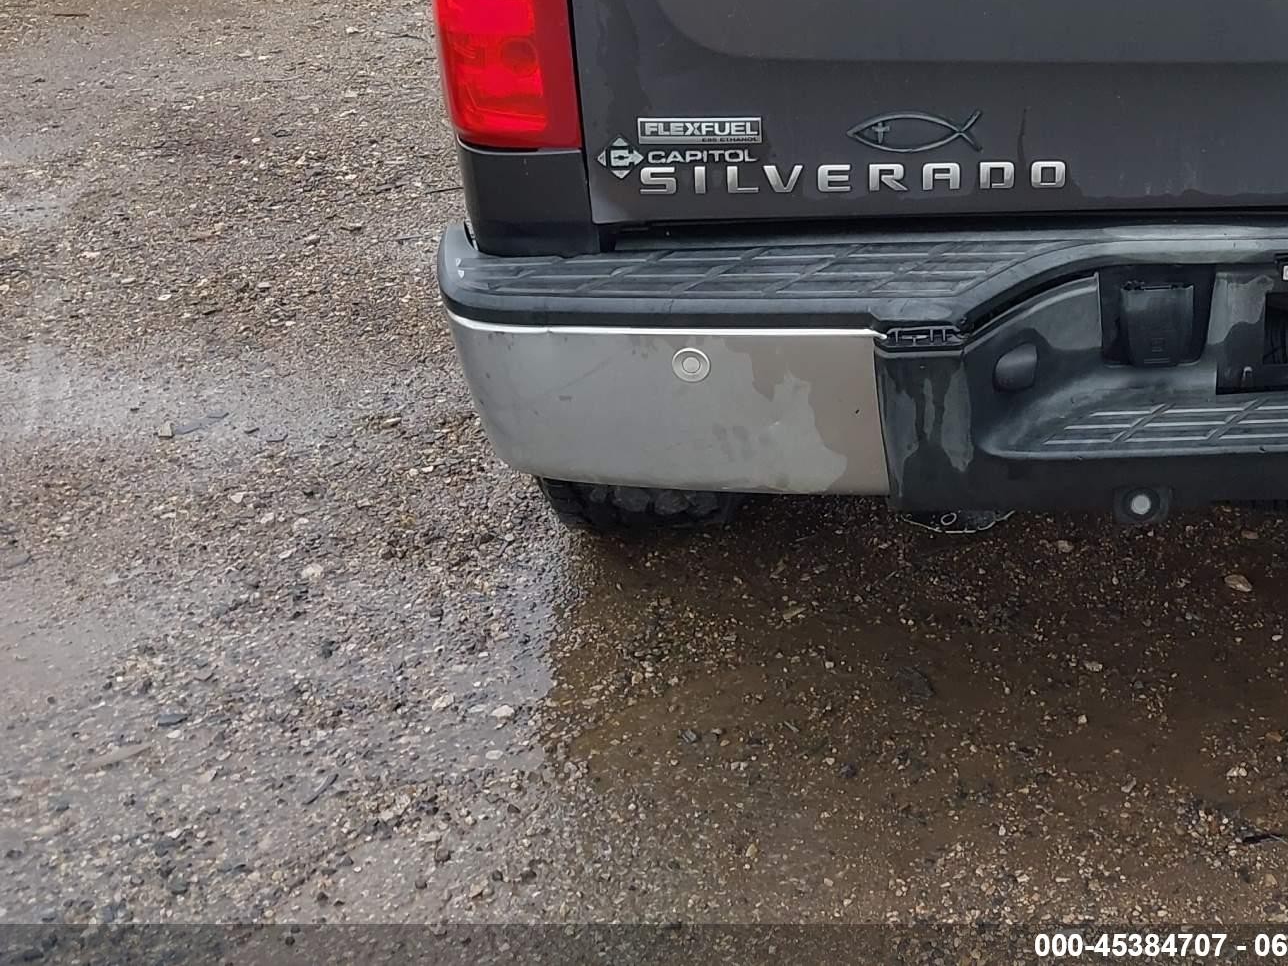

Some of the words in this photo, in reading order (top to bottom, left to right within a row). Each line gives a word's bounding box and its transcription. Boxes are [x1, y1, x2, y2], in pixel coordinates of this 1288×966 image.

[644, 122, 758, 136] FLEXFUEL
[647, 149, 758, 164] CAPITOL
[639, 161, 1067, 195] SILVERADO
